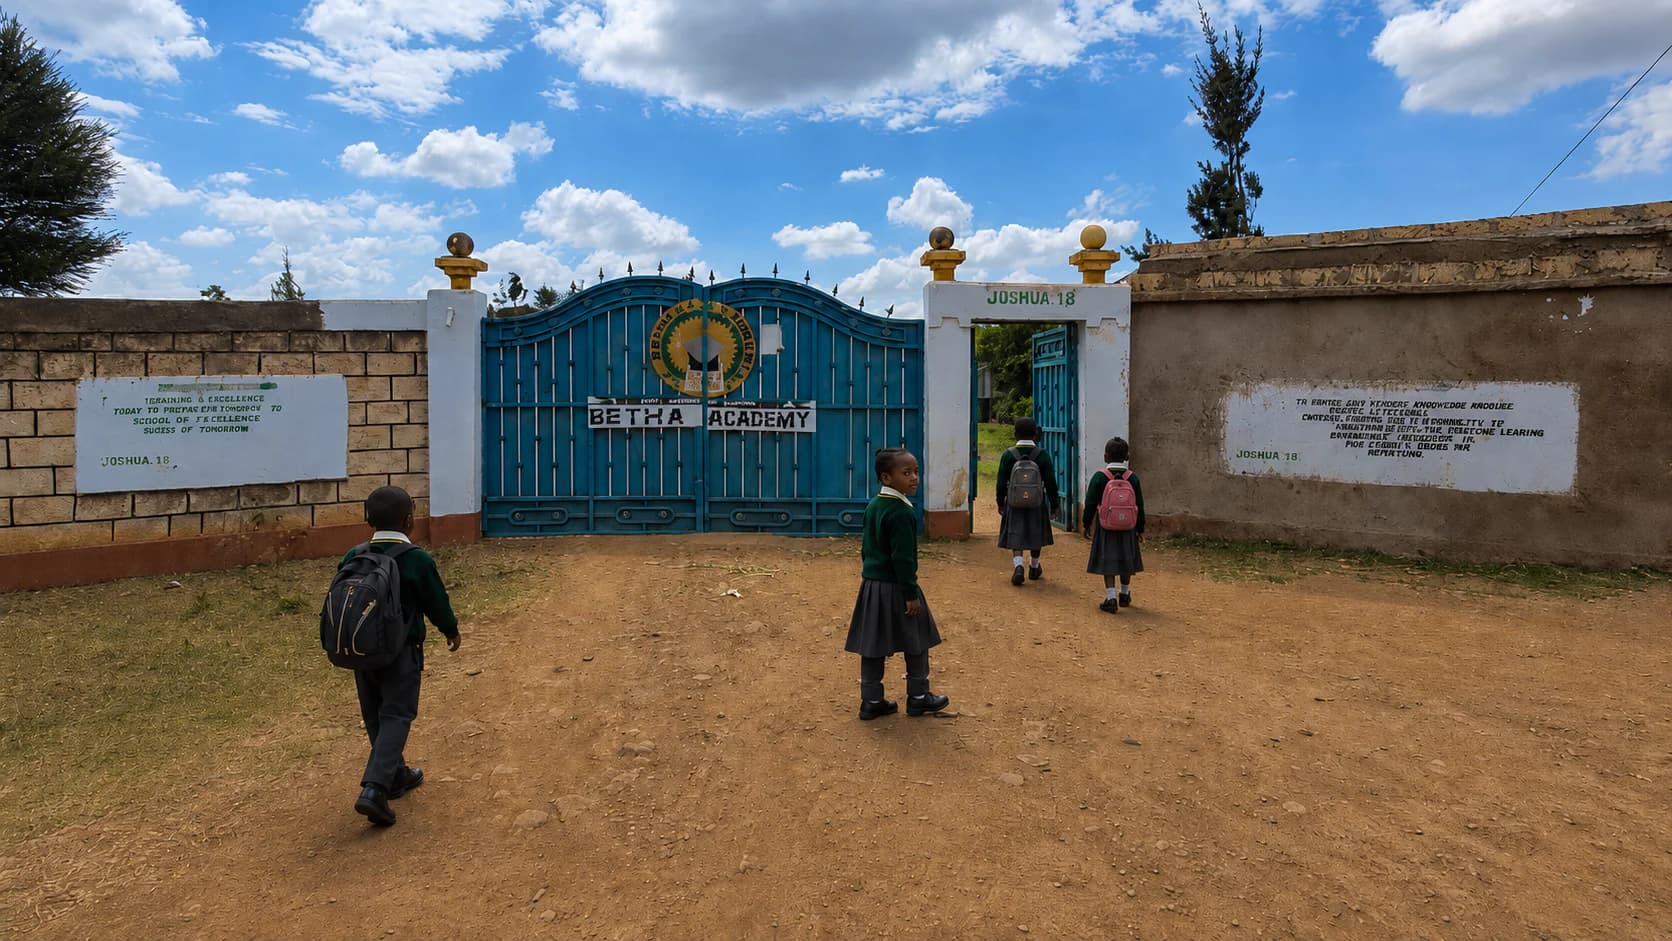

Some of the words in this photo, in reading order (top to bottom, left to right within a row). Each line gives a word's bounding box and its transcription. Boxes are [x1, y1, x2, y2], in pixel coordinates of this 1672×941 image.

[1057, 291, 1076, 305] 18
[113, 407, 142, 415] TODAY
[589, 408, 684, 425] BETHA
[708, 410, 810, 429] ACADEMY
[1500, 428, 1544, 437] LEARING
